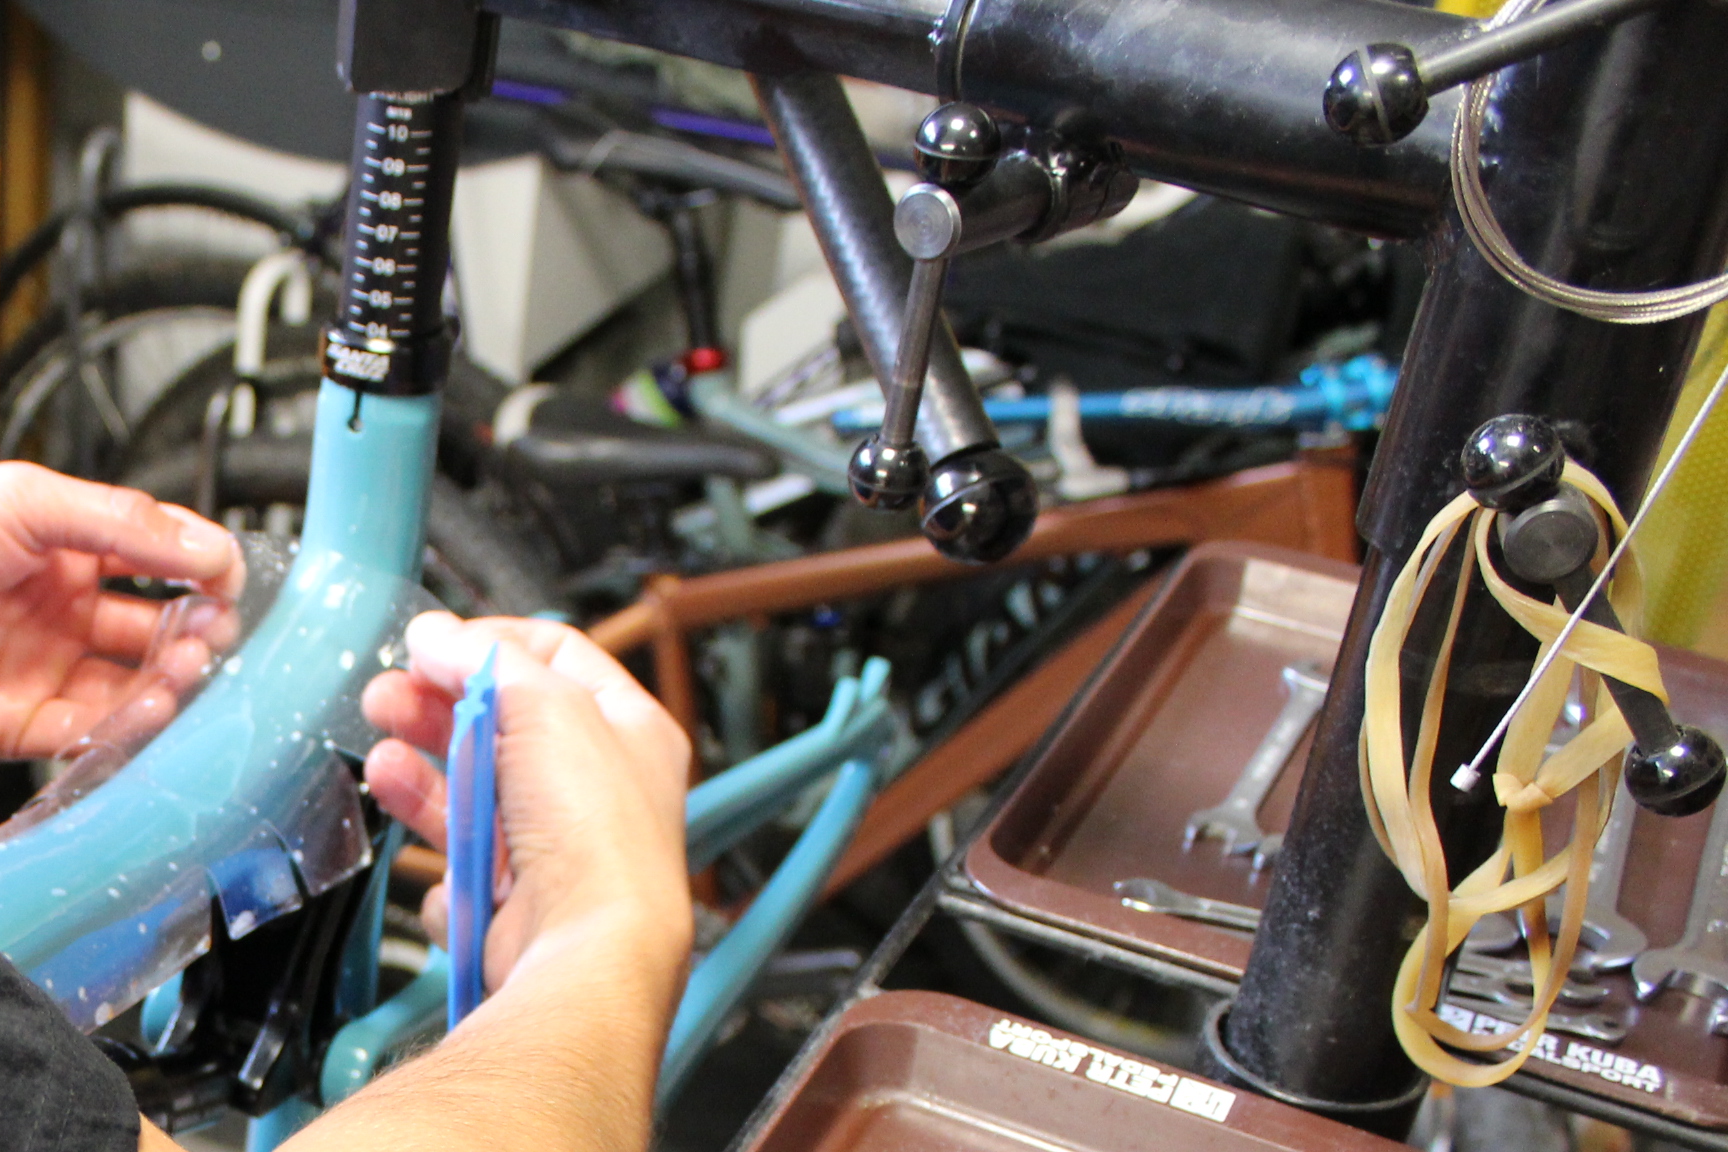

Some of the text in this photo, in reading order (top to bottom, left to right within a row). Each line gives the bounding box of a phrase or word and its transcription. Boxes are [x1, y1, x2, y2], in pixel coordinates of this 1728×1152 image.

[388, 124, 409, 142] 10
[381, 157, 405, 177] 09
[378, 190, 402, 210] 08
[375, 224, 399, 243] 07
[372, 257, 396, 277] 06
[369, 289, 393, 309] 05
[366, 321, 388, 339] 04
[993, 1018, 1179, 1087] PEDALSPORT
[1474, 1013, 1663, 1083] PER KUBA
[989, 1027, 1173, 1104] PETR KUBA
